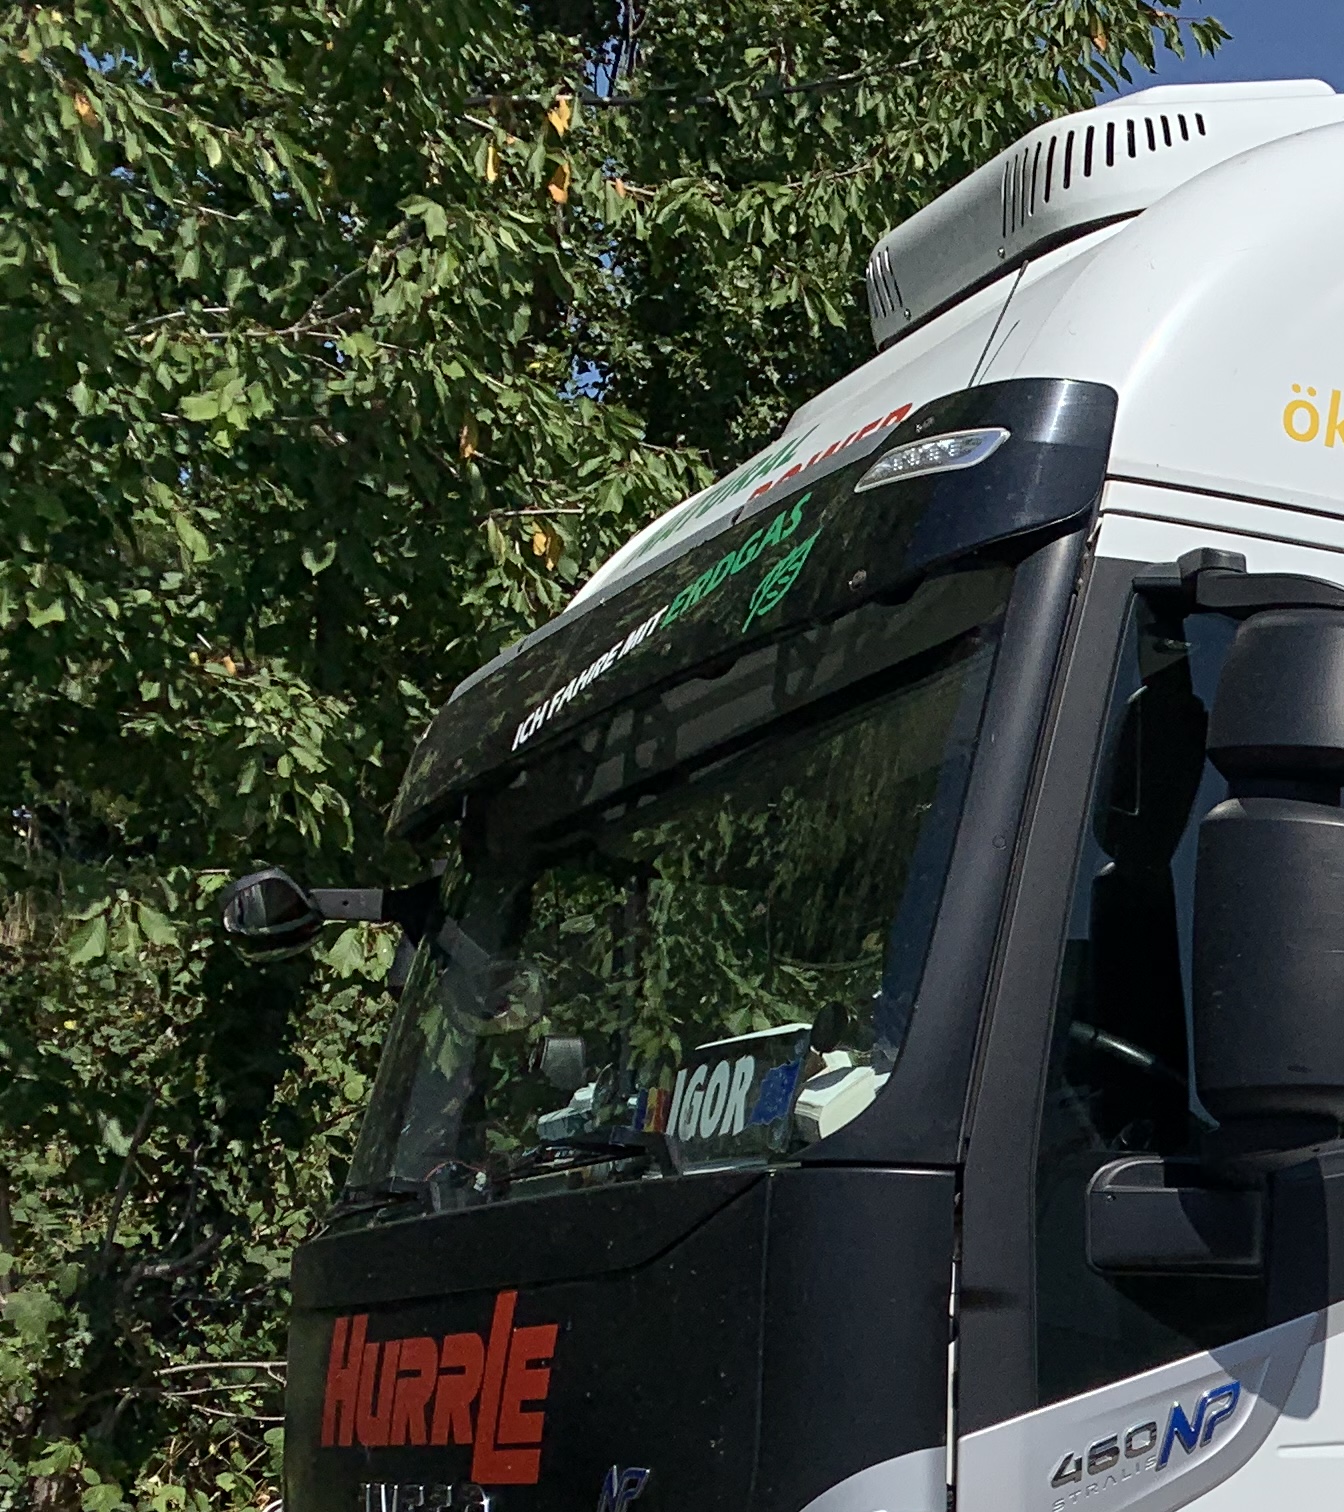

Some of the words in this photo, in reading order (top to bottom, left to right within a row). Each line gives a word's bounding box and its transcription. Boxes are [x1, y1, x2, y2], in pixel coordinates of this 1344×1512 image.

[512, 700, 550, 751] ICH
[546, 640, 624, 720] FAHRE
[660, 491, 813, 629] ERDGAS
[666, 1054, 755, 1142] IGOR
[321, 1289, 559, 1485] HURRLE
